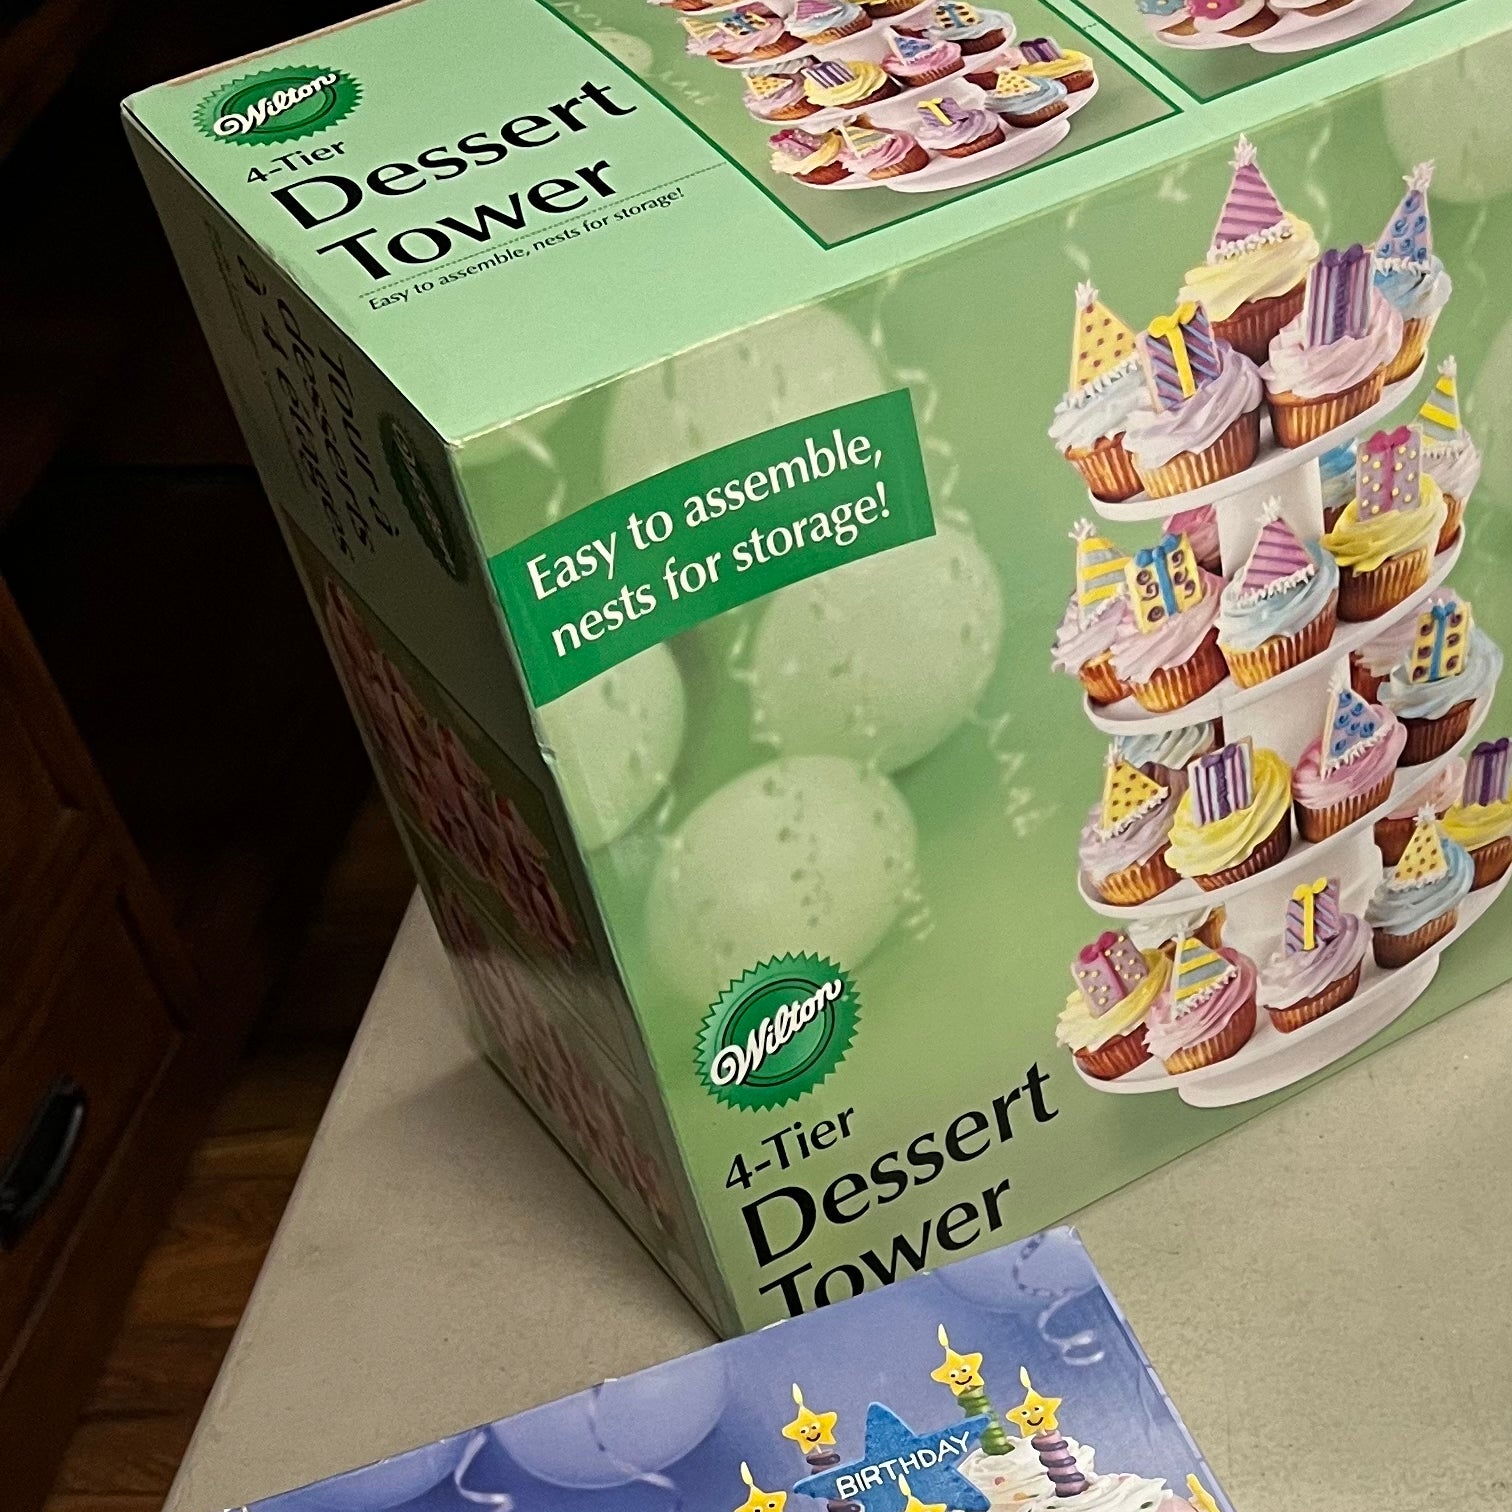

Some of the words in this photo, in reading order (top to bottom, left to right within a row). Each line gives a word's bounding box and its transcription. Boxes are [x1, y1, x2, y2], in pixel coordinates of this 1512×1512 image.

[213, 72, 337, 136] Wilton
[246, 140, 346, 184] 4-Tier
[271, 80, 638, 230] Dessert
[317, 157, 618, 281] Tower
[369, 288, 410, 310] Easy
[413, 278, 434, 295] to
[438, 246, 530, 287] assemble,
[533, 228, 581, 252] nests
[582, 214, 610, 235] for
[613, 187, 685, 223] storage!
[527, 531, 618, 602] Easy
[627, 510, 674, 551] to
[683, 429, 883, 529] assemble,
[551, 583, 656, 657] nests
[663, 551, 722, 601] for
[732, 481, 890, 571] storage!
[711, 979, 843, 1086] Wilton
[725, 1107, 854, 1190] 4-Tier
[741, 1061, 1059, 1268] Dessert
[759, 1178, 1011, 1318] Tower
[837, 1431, 971, 1499] BIRTHDAY
